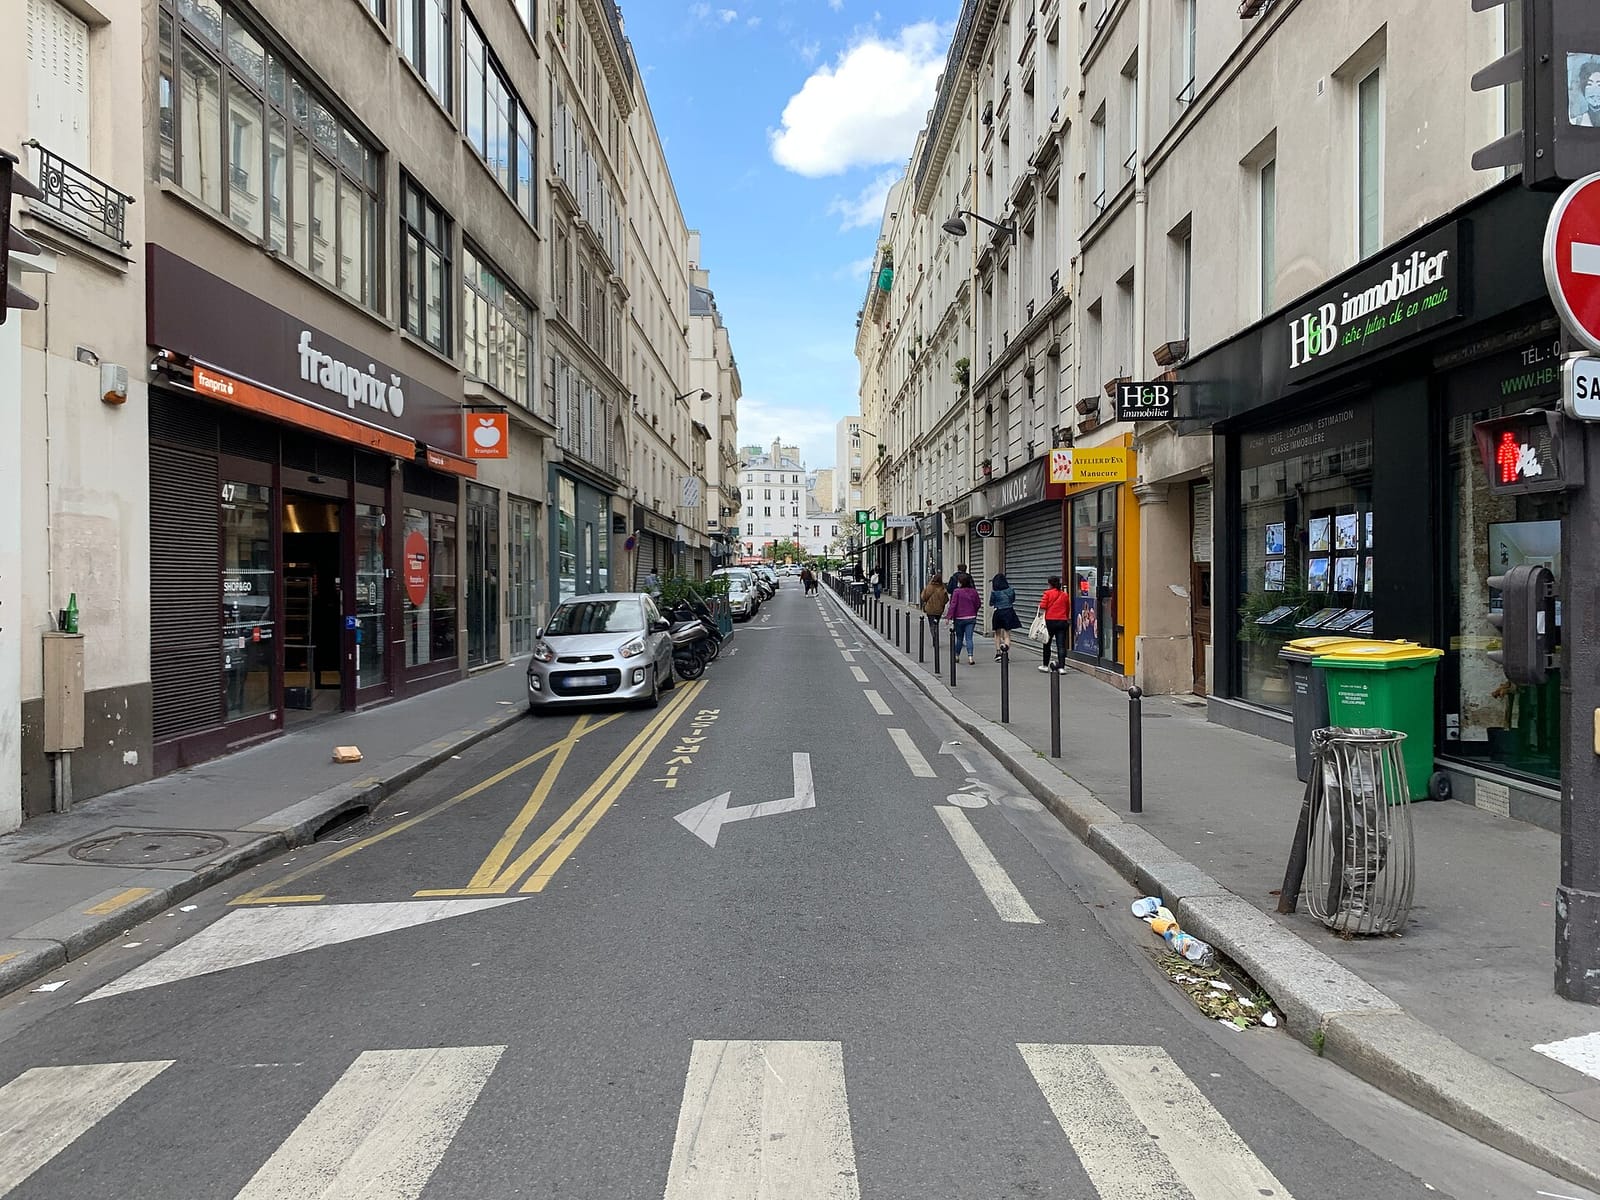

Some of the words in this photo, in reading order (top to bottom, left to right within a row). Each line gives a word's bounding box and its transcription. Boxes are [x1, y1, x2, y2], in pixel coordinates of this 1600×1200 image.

[1289, 303, 1338, 369] H&B
[1340, 250, 1448, 326] immobilier
[1407, 302, 1419, 318] en
[1421, 287, 1449, 312] main
[198, 371, 228, 394] franprix
[298, 330, 388, 413] franprix
[1121, 385, 1170, 408] H&B
[1576, 375, 1600, 400] SA
[1122, 407, 1169, 418] immobilier
[1287, 422, 1314, 439] LOCATION
[1317, 409, 1354, 430] ESTIMATION
[1080, 470, 1118, 478] Manucure
[221, 483, 236, 502] 47
[1002, 475, 1028, 508] NIKOLE
